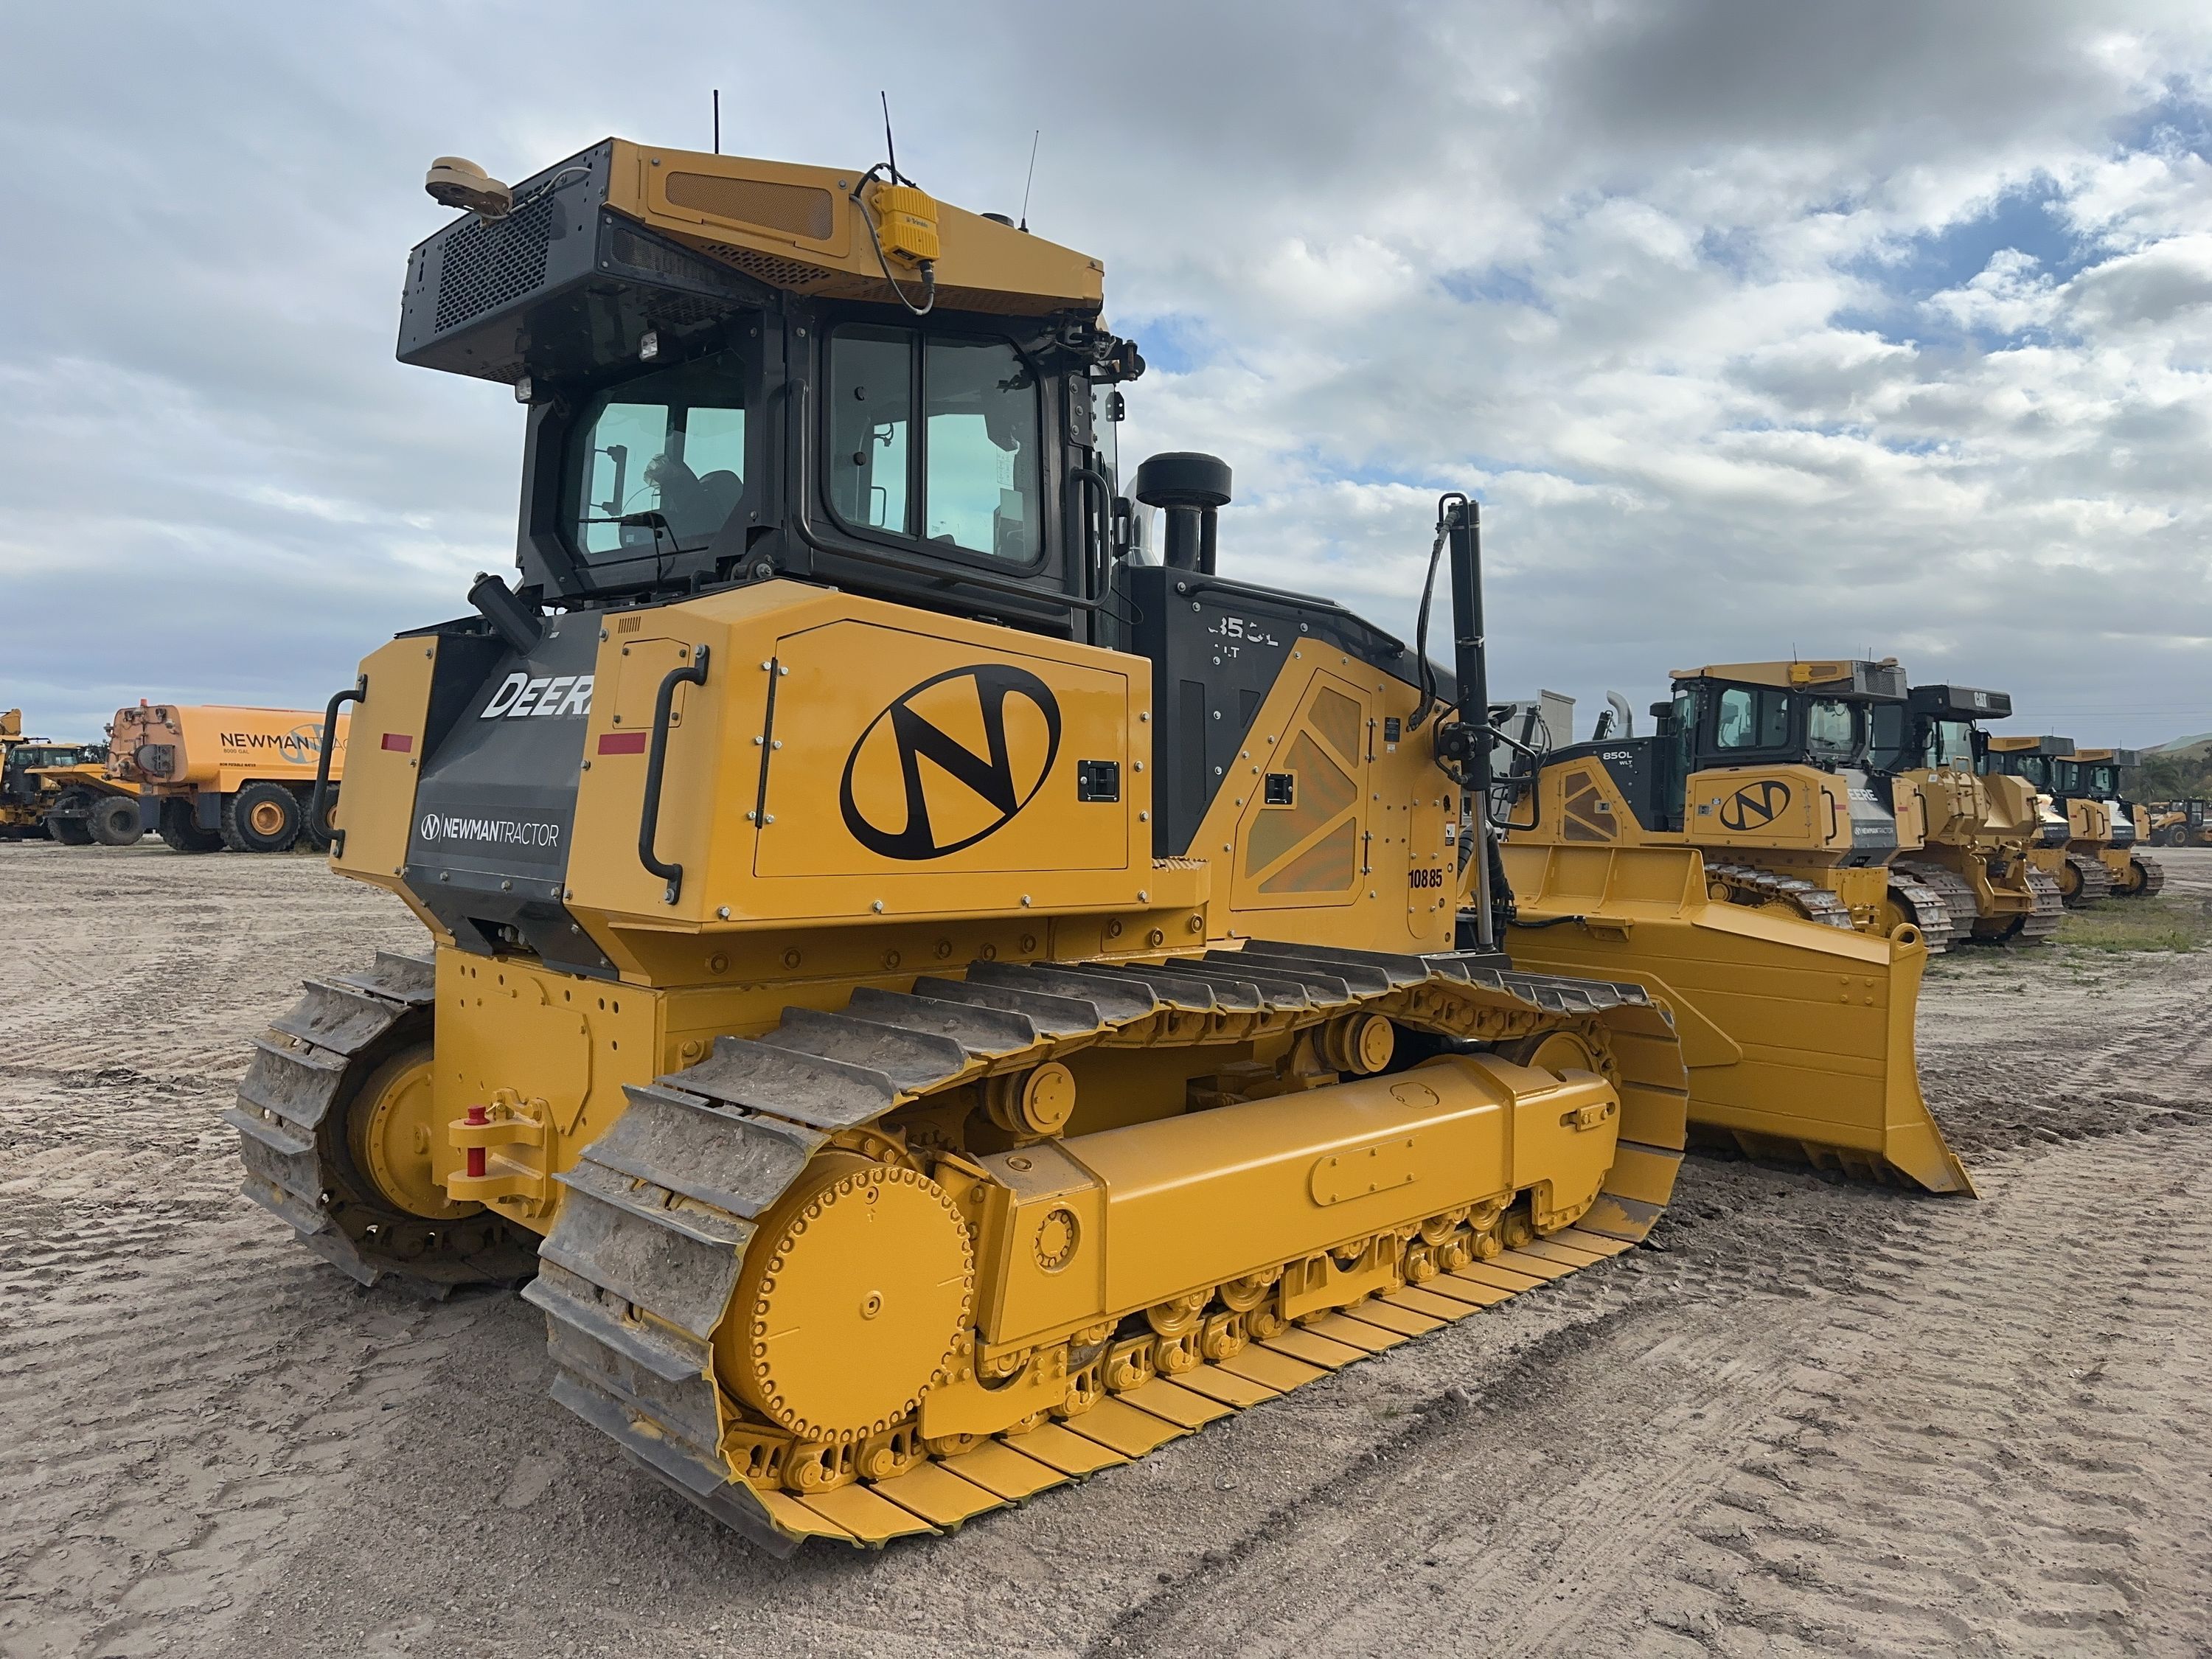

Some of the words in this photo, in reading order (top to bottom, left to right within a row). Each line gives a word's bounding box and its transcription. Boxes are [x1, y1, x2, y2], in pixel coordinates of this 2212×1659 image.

[480, 672, 595, 718] DEER
[1974, 692, 1987, 708] CAT
[1603, 751, 1632, 760] 850L
[1847, 788, 1879, 801] EERE
[442, 817, 560, 847] NEWMANTRACTOR
[1408, 869, 1443, 888] 10885
